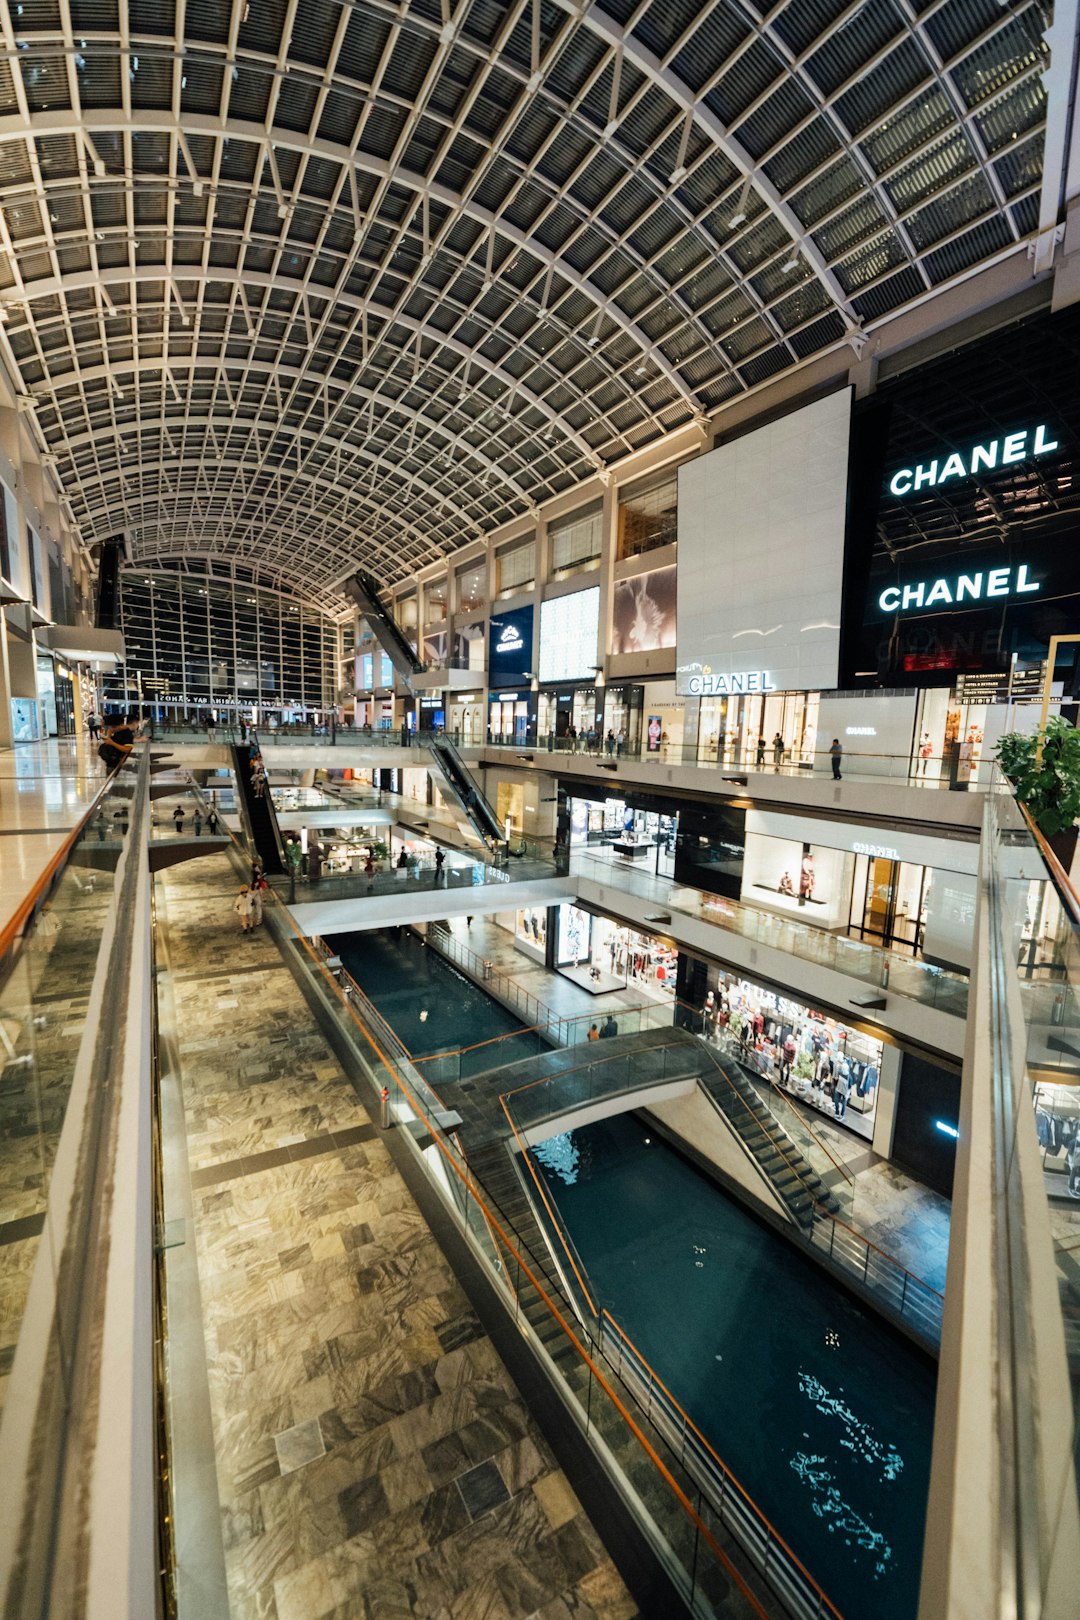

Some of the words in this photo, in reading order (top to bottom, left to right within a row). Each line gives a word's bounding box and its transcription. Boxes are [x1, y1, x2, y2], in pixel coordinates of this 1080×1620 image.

[889, 424, 1058, 496] CHANEL
[878, 564, 1040, 612] CHANEL
[688, 671, 774, 694] CHANEL
[852, 842, 901, 861] CHANEL
[740, 980, 801, 1017] GUESS
